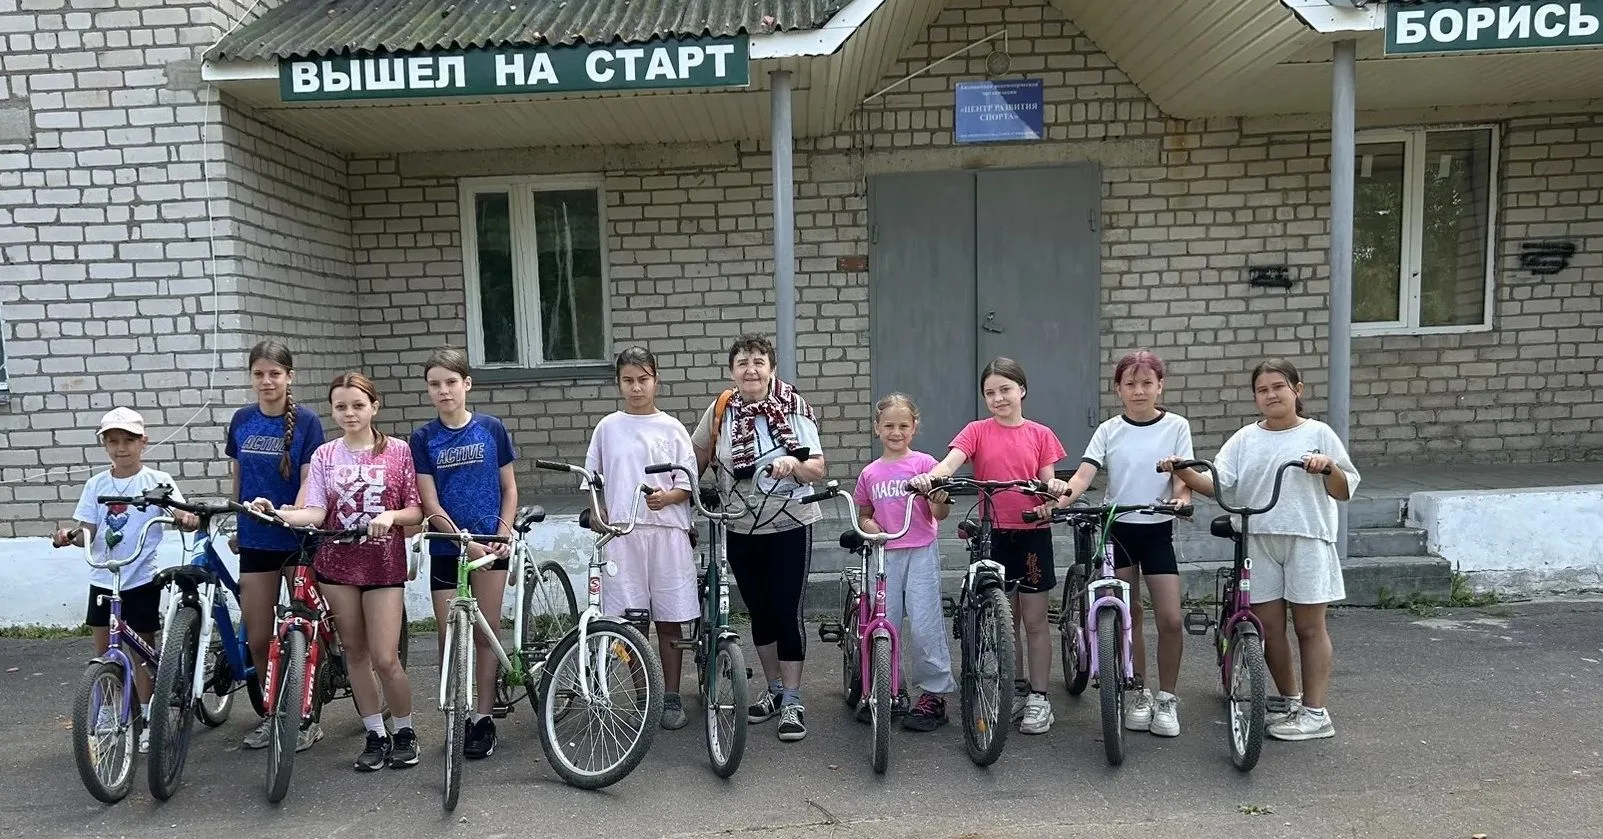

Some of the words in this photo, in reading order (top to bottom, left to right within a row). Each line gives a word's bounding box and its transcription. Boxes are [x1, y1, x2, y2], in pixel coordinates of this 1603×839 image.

[1395, 2, 1600, 45] БОРИСЬ
[291, 56, 466, 93] ВЫШЕЛ
[495, 52, 560, 87] НА
[585, 44, 735, 83] СТАРТ
[436, 442, 485, 465] ACTIVE
